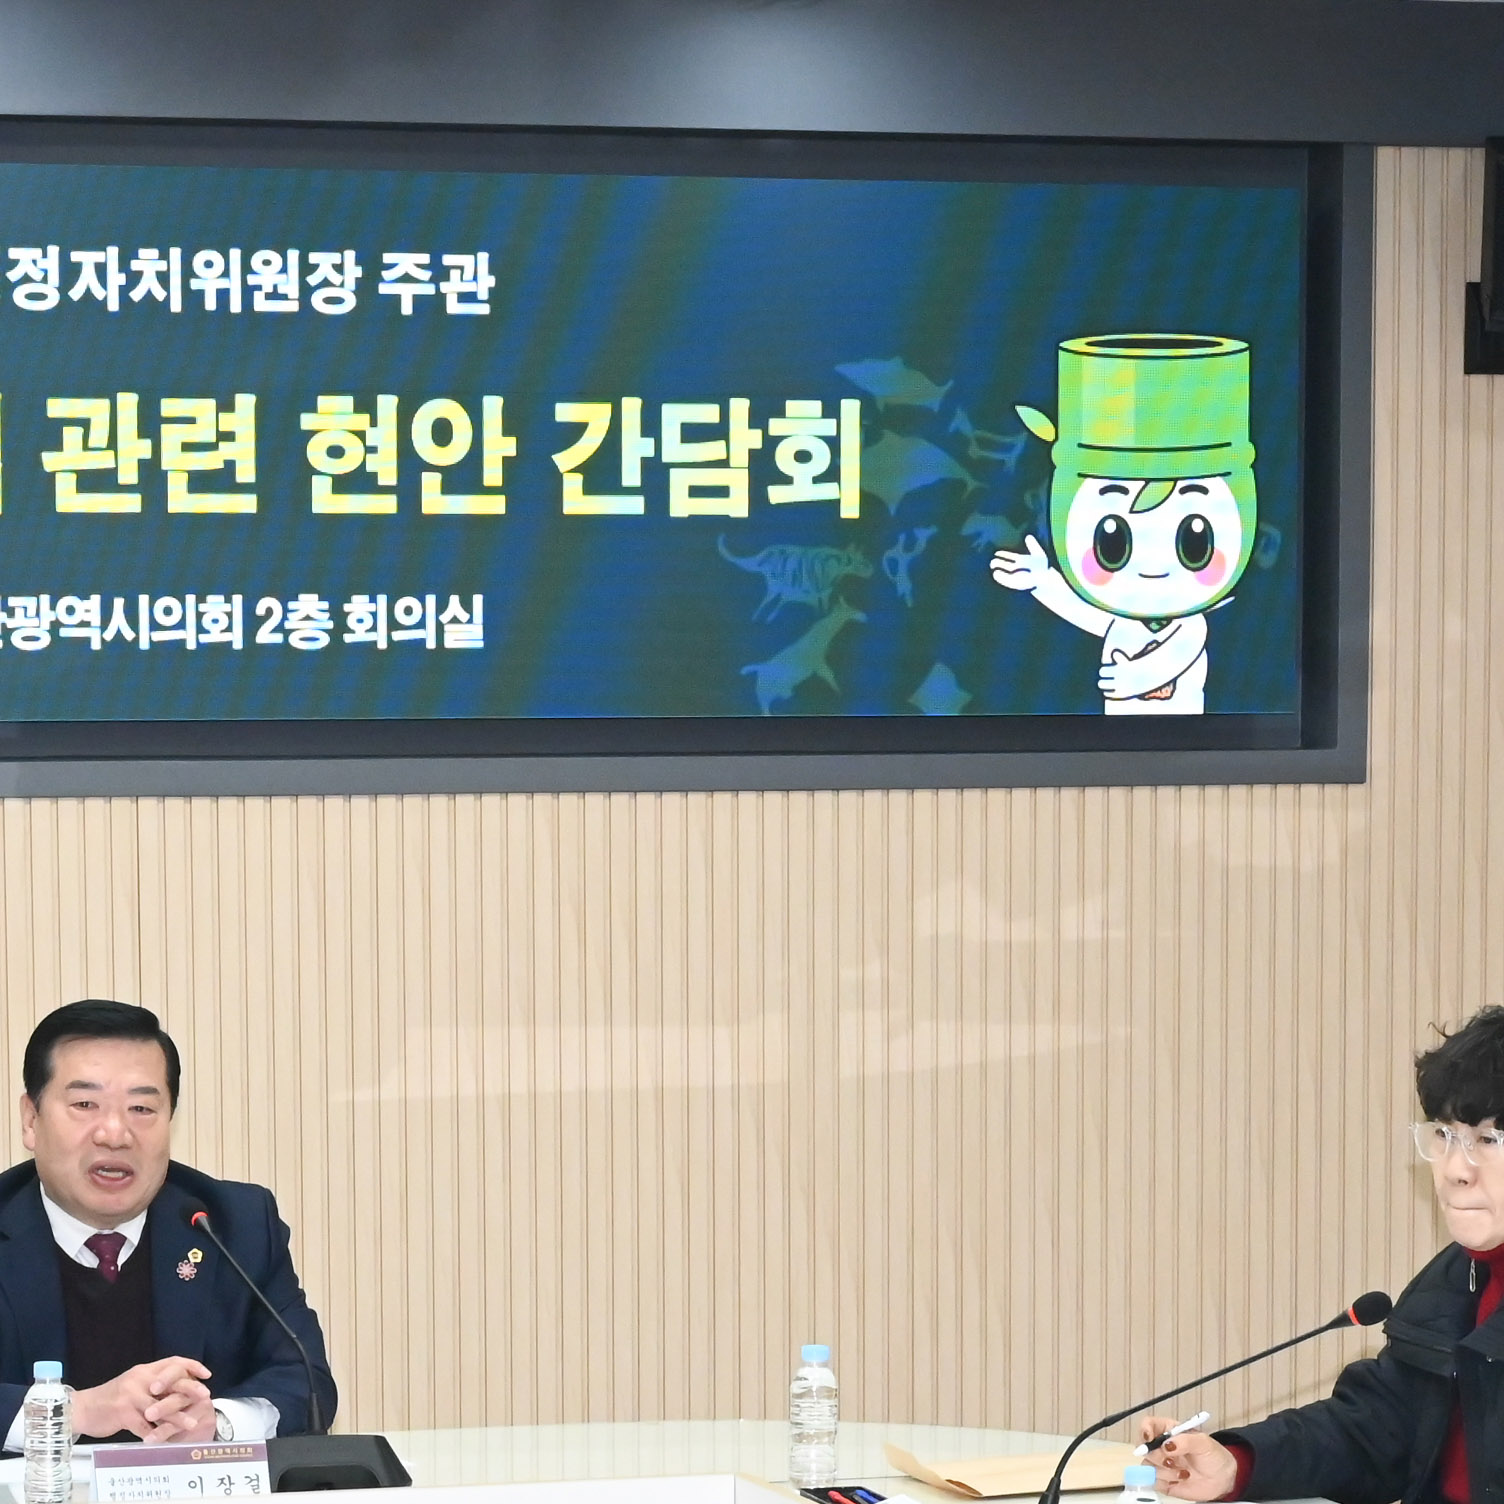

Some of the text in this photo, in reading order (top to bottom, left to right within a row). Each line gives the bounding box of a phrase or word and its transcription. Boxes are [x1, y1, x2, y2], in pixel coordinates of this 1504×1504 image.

[378, 251, 496, 316] 주관
[41, 391, 258, 514] 관련
[299, 394, 517, 515] 현안
[551, 396, 867, 520] 간담회
[255, 594, 334, 650] 2층
[342, 593, 484, 650] 회의실
